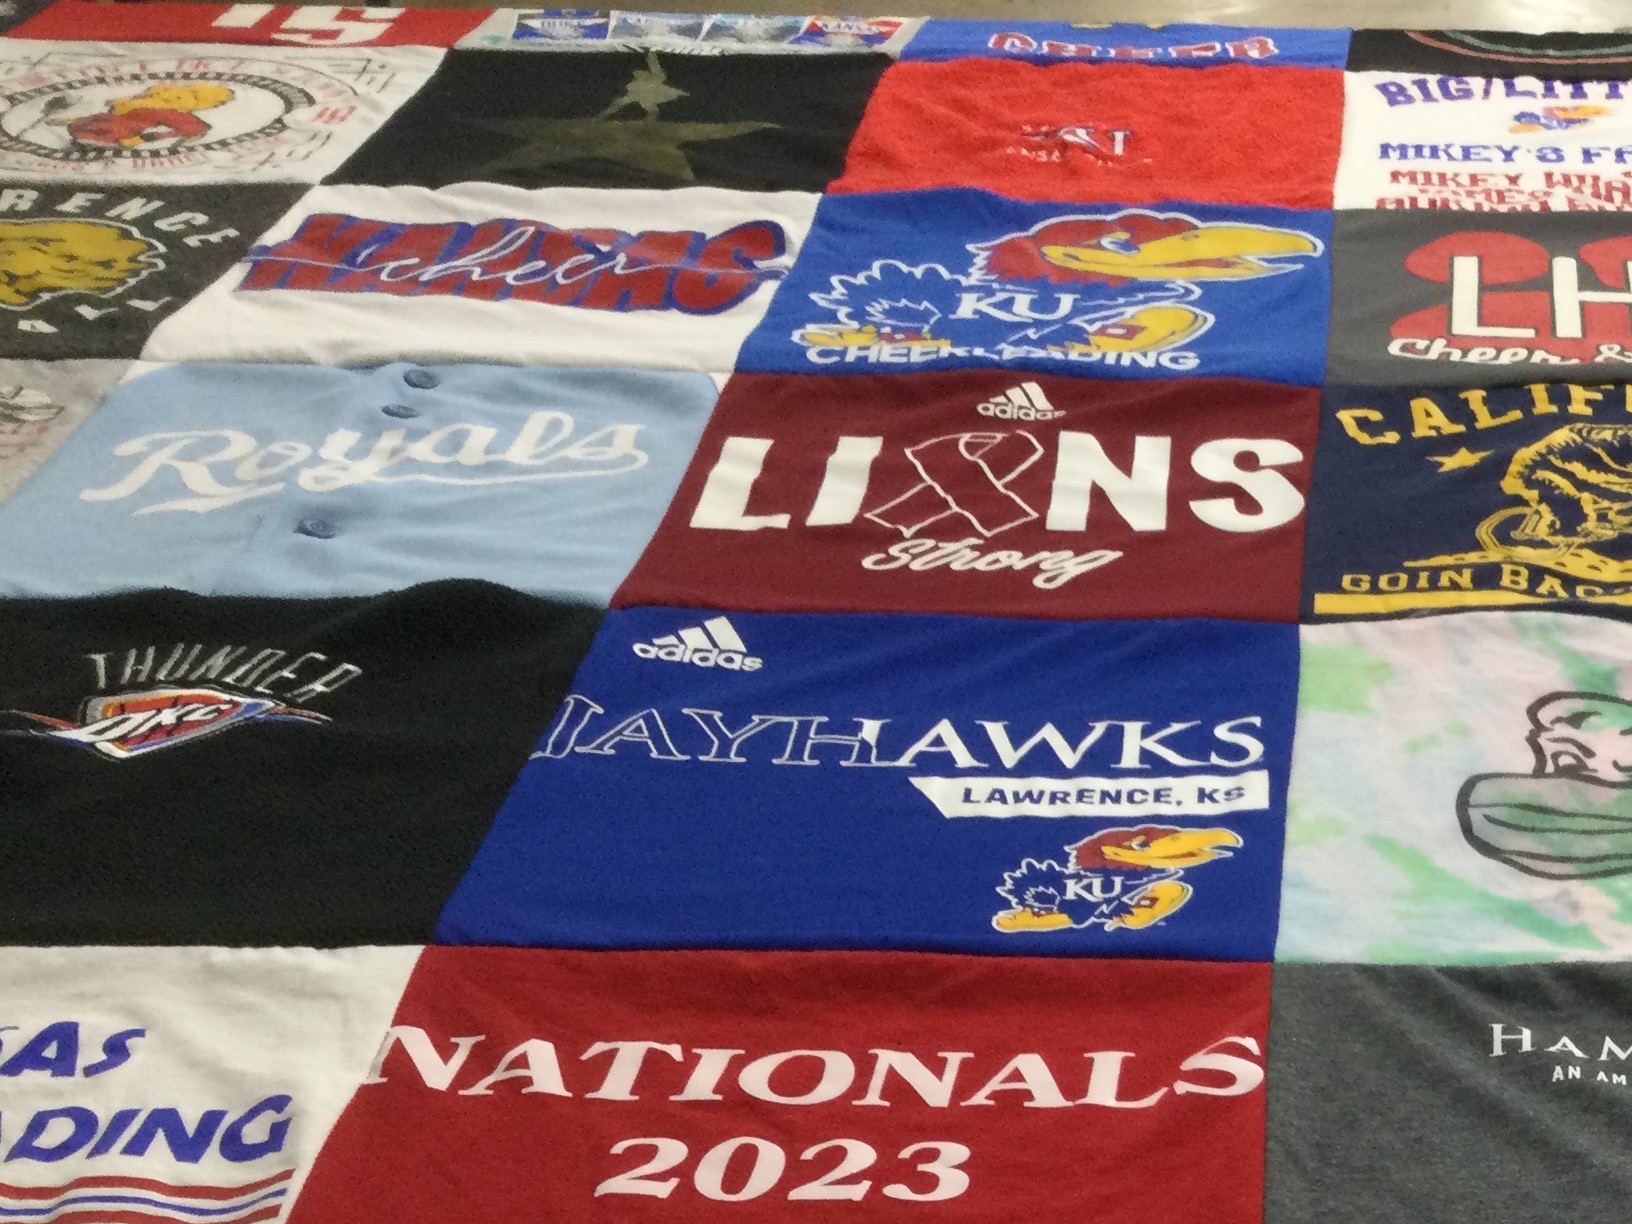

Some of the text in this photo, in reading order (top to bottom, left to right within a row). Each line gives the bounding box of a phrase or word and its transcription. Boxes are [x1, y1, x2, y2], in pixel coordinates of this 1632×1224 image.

[1389, 169, 1524, 189] MIKEY
[948, 292, 1081, 323] KU
[1387, 336, 1580, 366] Cheer
[79, 410, 649, 516] Royals
[689, 430, 1305, 534] LINS
[860, 537, 1125, 590] Strong
[1341, 567, 1476, 594] GOIN
[86, 643, 363, 703] THUNDER
[632, 640, 763, 673] adidas
[529, 693, 1267, 769] JAYHAWKS
[1195, 785, 1247, 806] KS
[1061, 874, 1126, 902] KU
[0, 1020, 147, 1079] AS
[360, 1024, 1268, 1112] NATIONALS
[1552, 1064, 1582, 1083] AN
[593, 1135, 973, 1203] 2023
